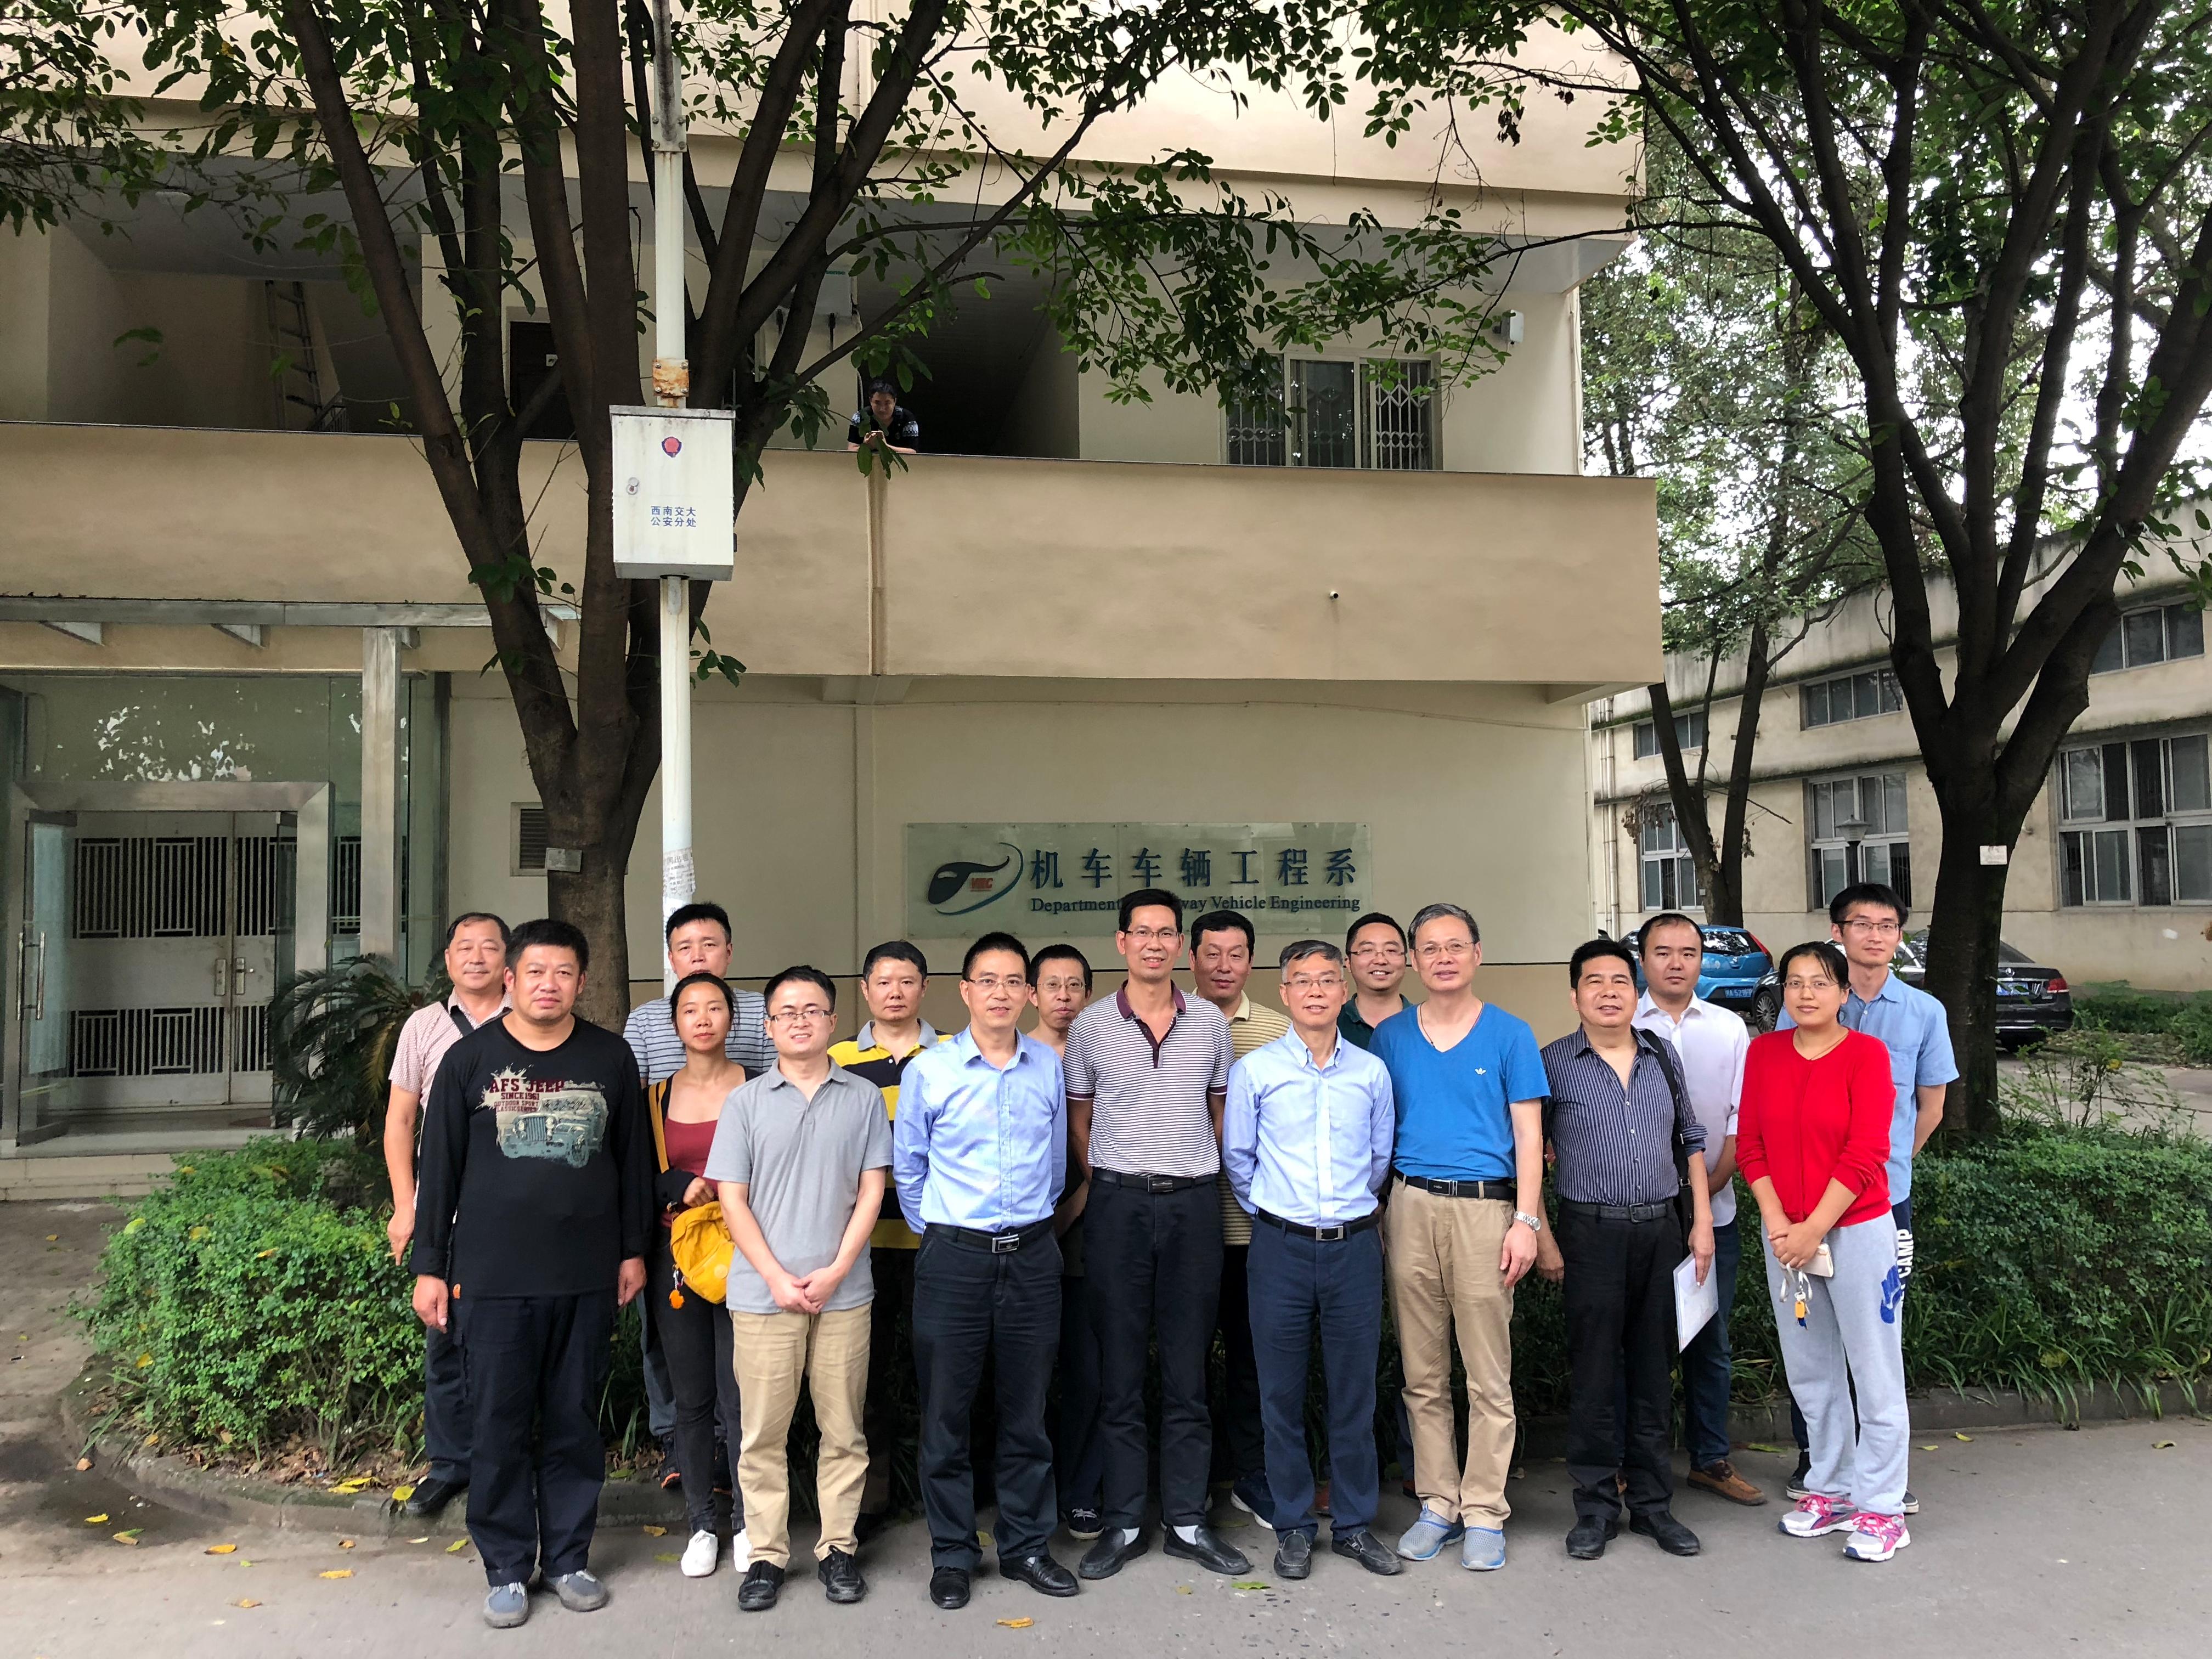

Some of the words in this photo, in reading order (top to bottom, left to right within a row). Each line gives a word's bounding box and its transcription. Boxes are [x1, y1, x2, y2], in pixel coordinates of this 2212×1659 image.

[651, 506, 696, 517] 西南交大
[651, 517, 696, 527] 公安分处
[1030, 847, 1356, 889] 机车车辆工程系
[1031, 898, 1120, 915] Department
[1210, 895, 1266, 910] Vehicle
[1270, 895, 1361, 913] Engineering
[489, 1078, 520, 1093] AFS
[1897, 1228, 1914, 1279] CAMP
